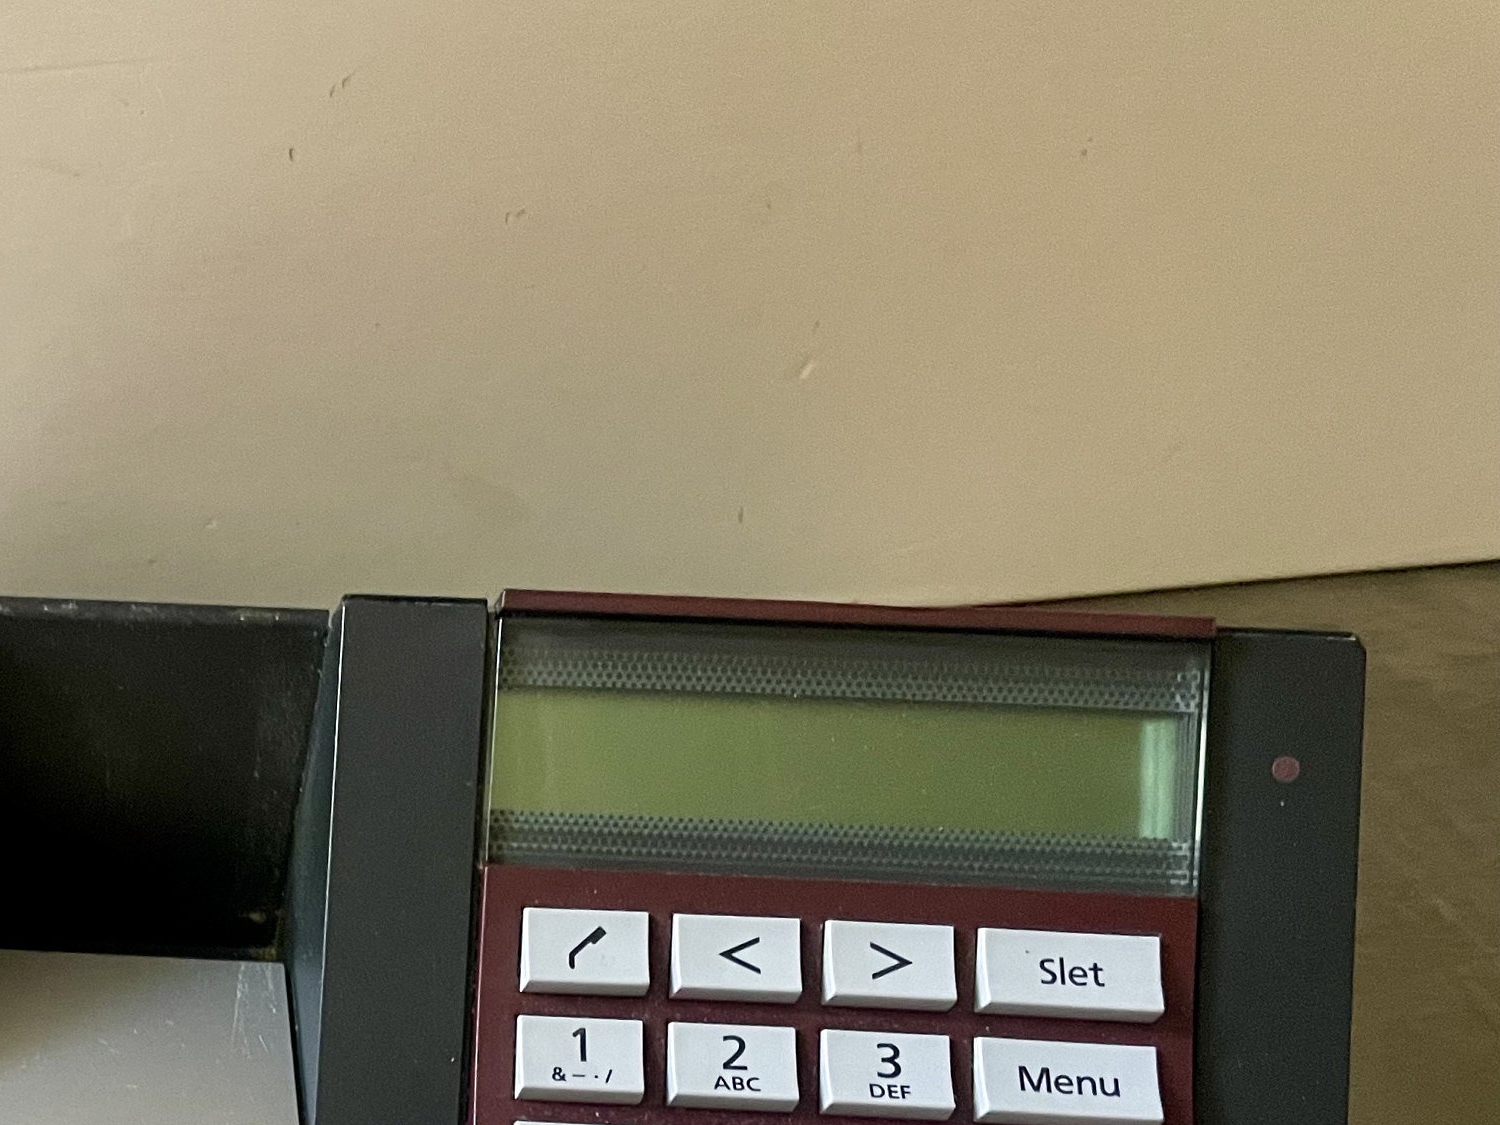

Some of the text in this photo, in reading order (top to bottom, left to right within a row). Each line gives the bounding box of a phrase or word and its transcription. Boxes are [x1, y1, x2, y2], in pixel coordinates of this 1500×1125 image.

[1039, 957, 1106, 988] Slet
[572, 1027, 587, 1063] 1
[722, 1034, 749, 1071] 2
[876, 1042, 902, 1079] 3
[713, 1075, 762, 1092] ABC
[868, 1083, 912, 1100] DEF
[1018, 1065, 1121, 1098] Menu
